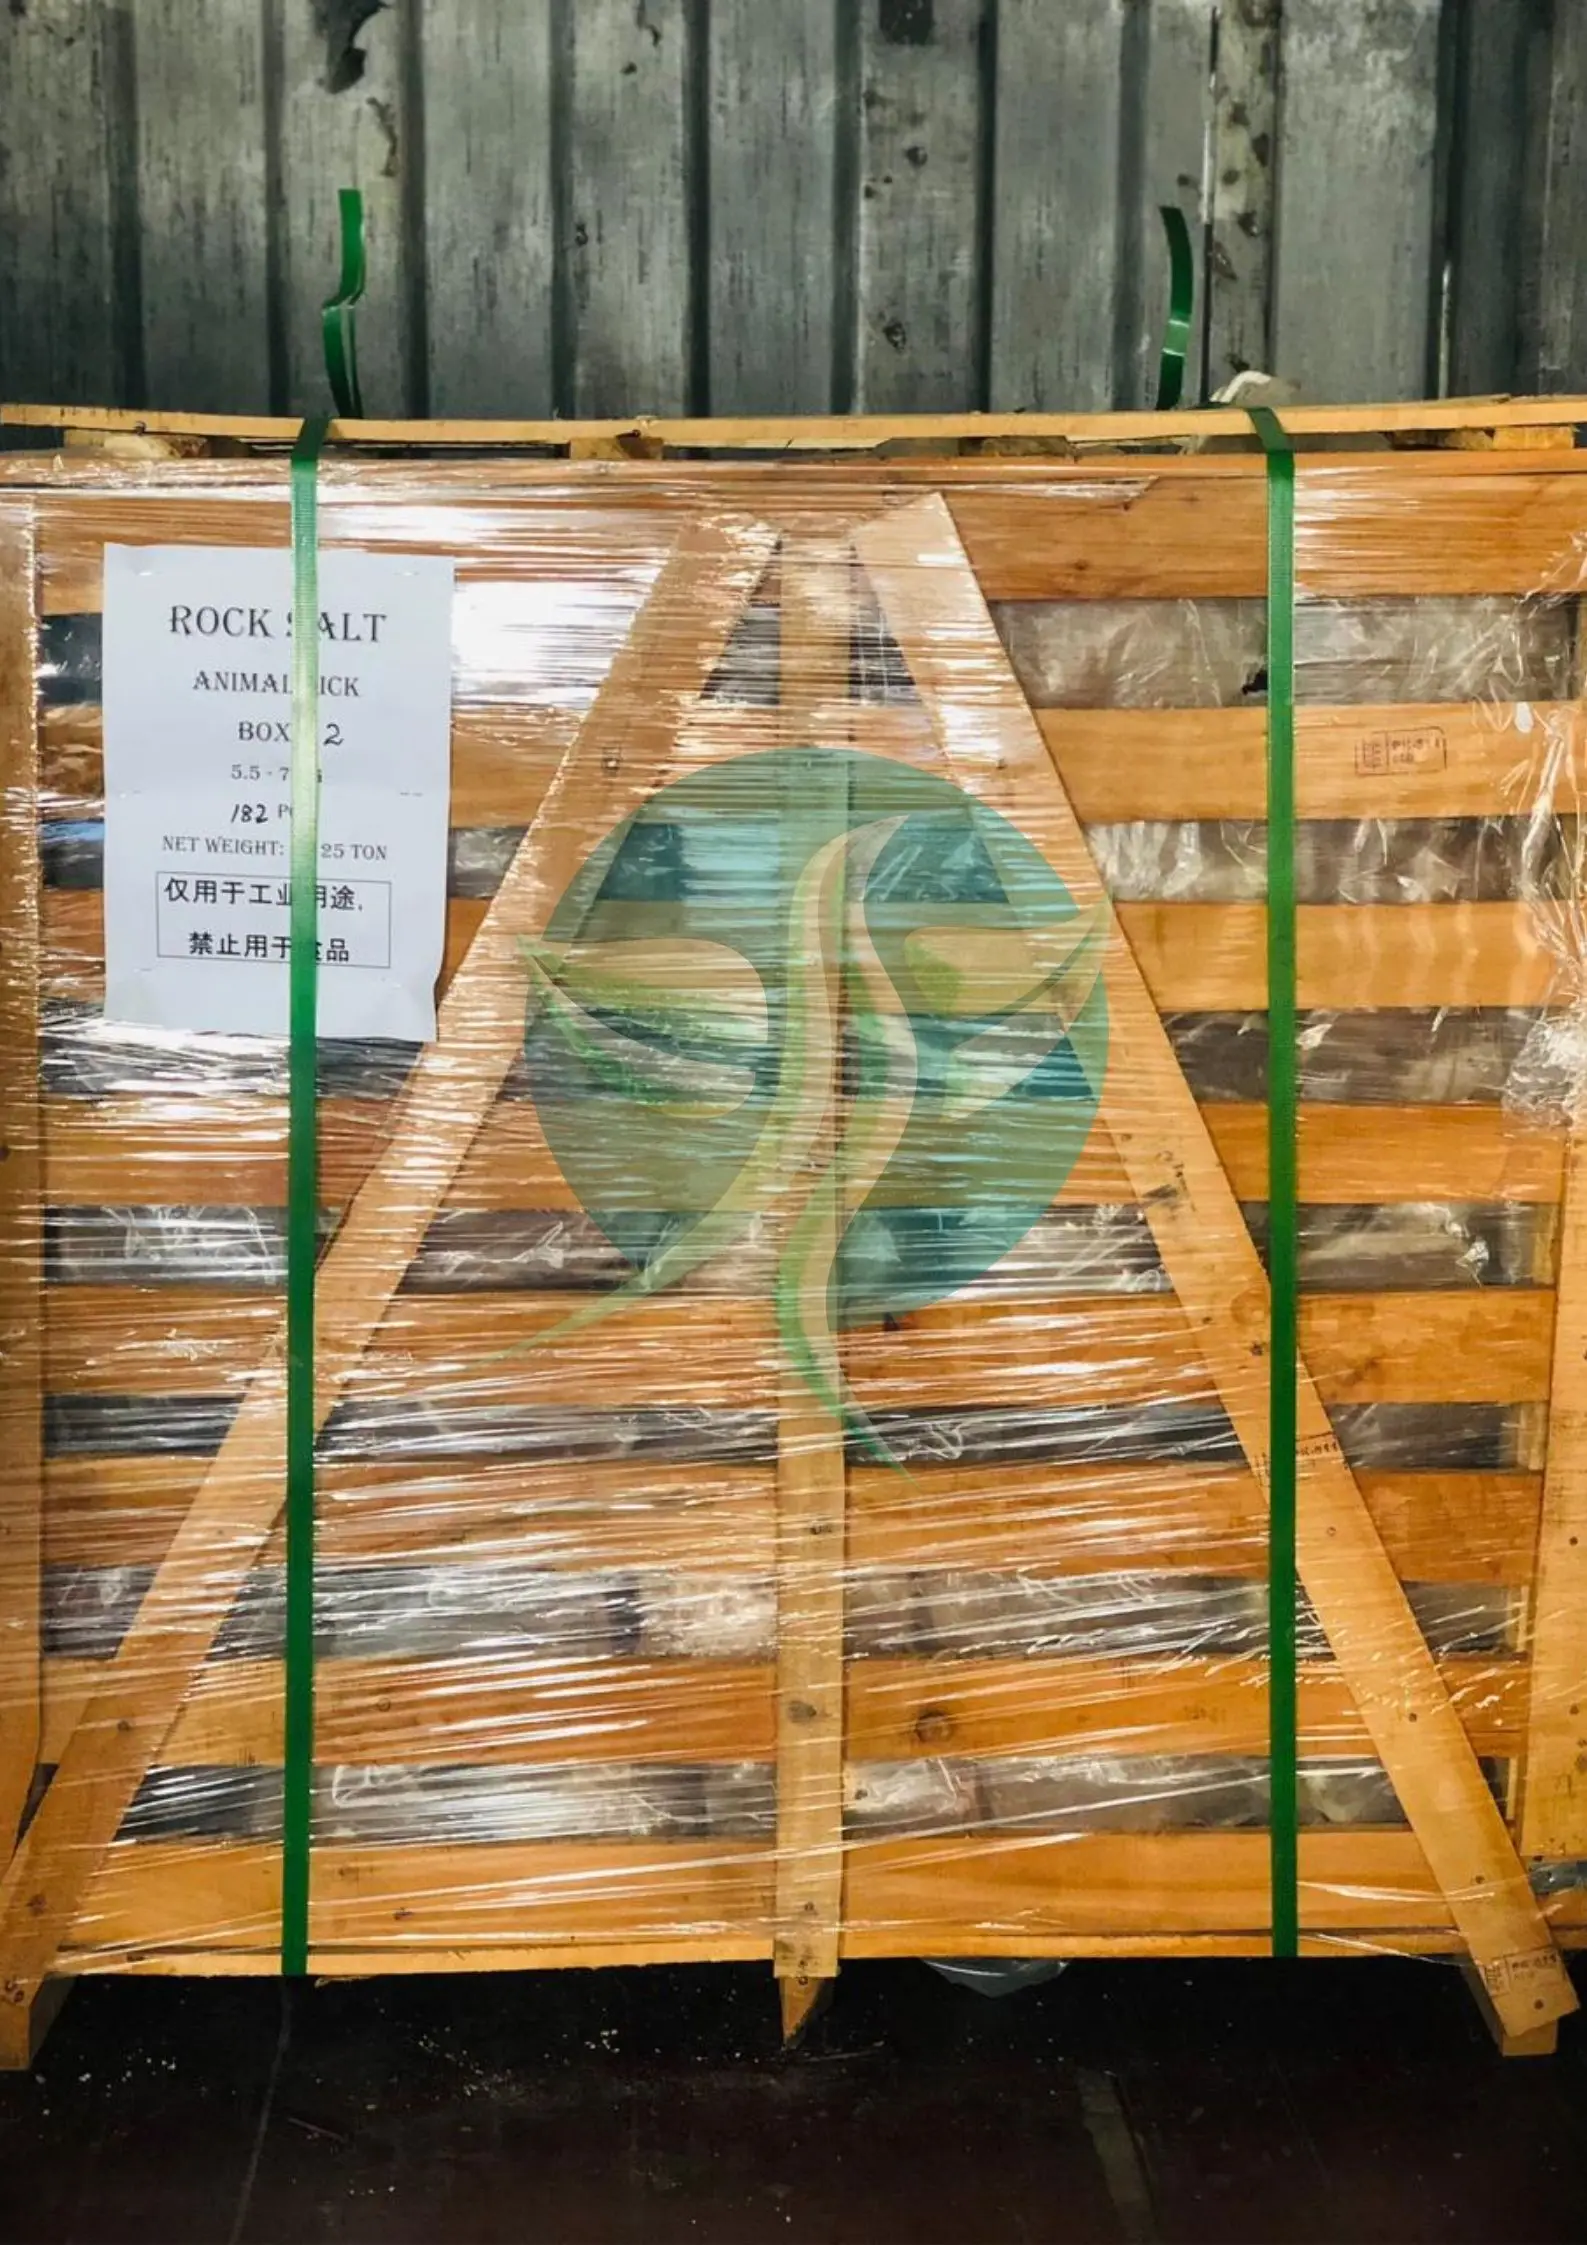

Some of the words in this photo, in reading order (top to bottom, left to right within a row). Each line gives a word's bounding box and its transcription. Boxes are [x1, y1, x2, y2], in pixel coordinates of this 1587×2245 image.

[169, 604, 273, 639] ROCK
[192, 670, 293, 695] ANIMAL
[317, 675, 361, 697] ICK
[238, 720, 291, 743] BOX
[323, 723, 344, 746] 2
[230, 764, 261, 781] 5.5
[230, 803, 269, 824] 182
[162, 836, 200, 853] NET
[205, 838, 285, 856] WEIGHT:
[350, 844, 388, 861] TON
[189, 932, 350, 962] 禁止用于品
